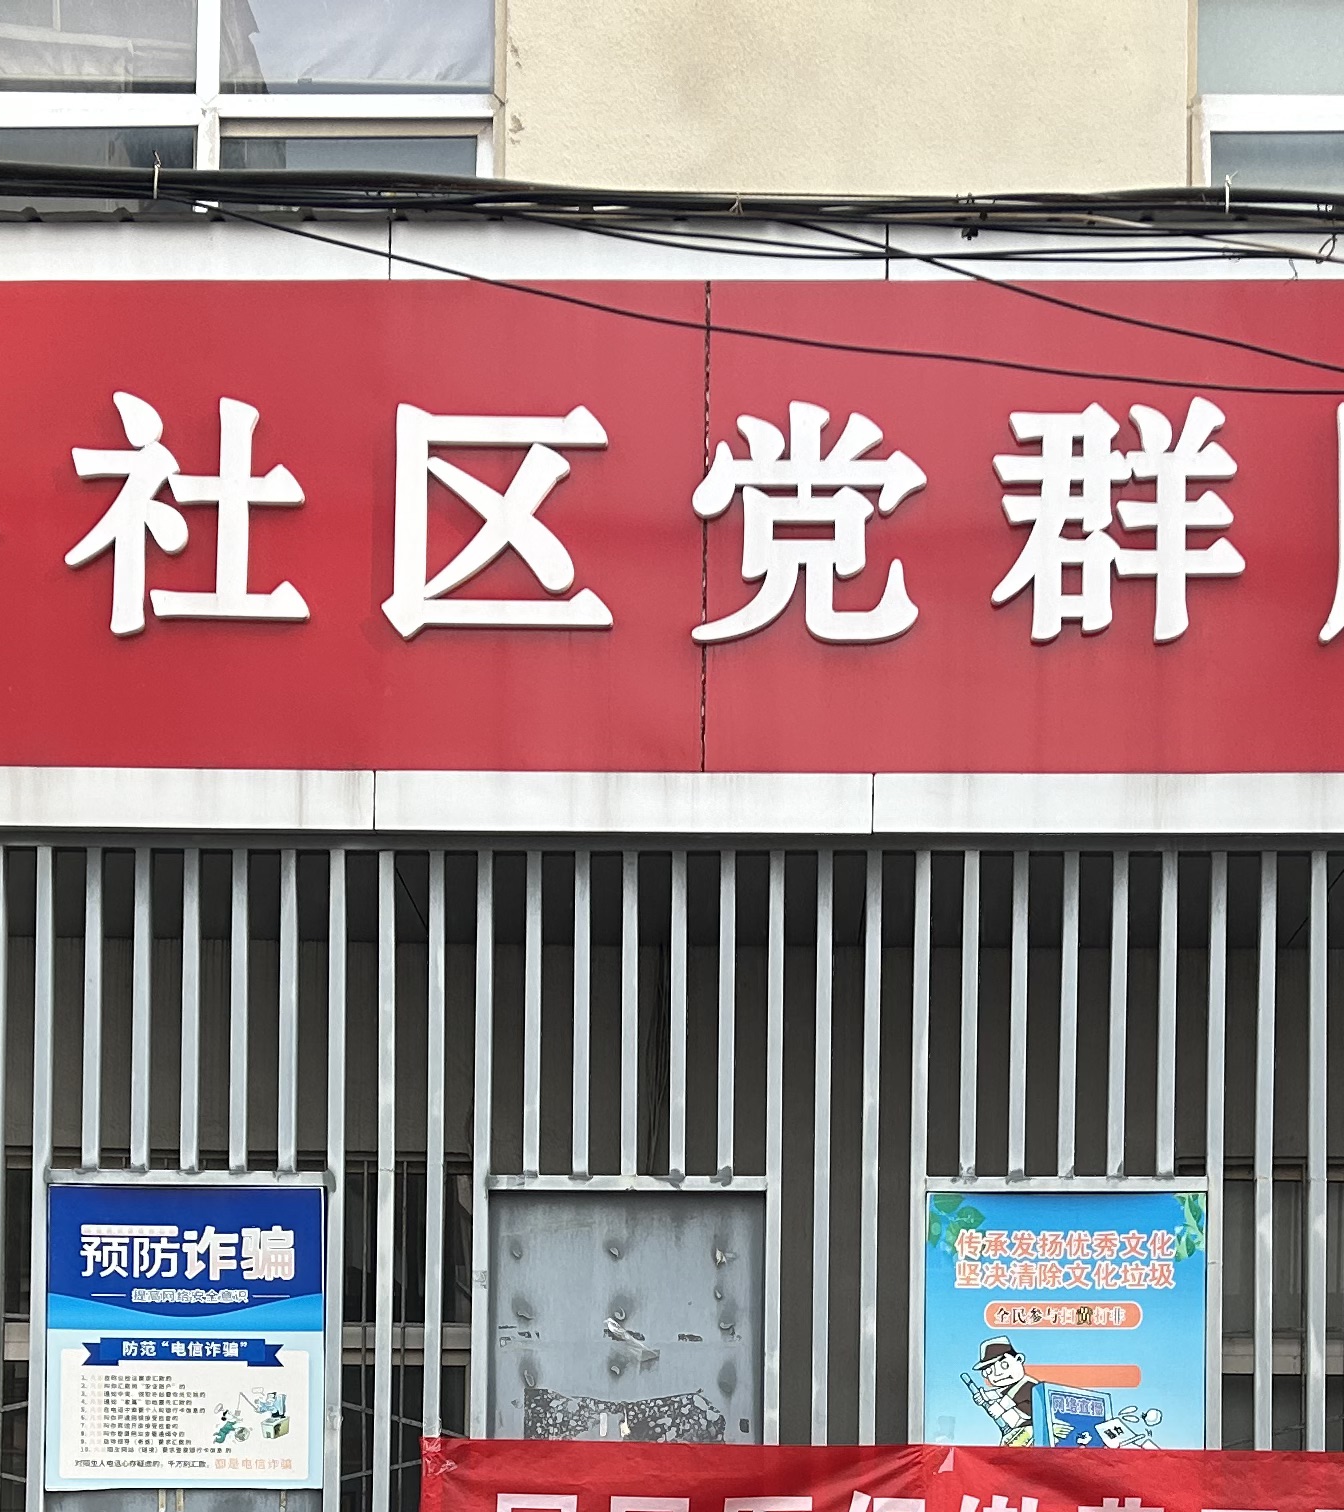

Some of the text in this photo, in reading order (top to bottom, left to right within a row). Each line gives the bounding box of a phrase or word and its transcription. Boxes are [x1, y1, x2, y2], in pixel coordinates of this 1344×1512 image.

[79, 1225, 296, 1281] 预防诈骗
[954, 1229, 1176, 1260] 传承发扬优秀文化
[954, 1261, 1176, 1290] 坚决清除文化垃圾
[131, 1288, 249, 1303] 提高网络安全意识
[993, 1306, 1126, 1325] 全民参与扫黄打非
[122, 1341, 248, 1357] 防范“电信诈骗”
